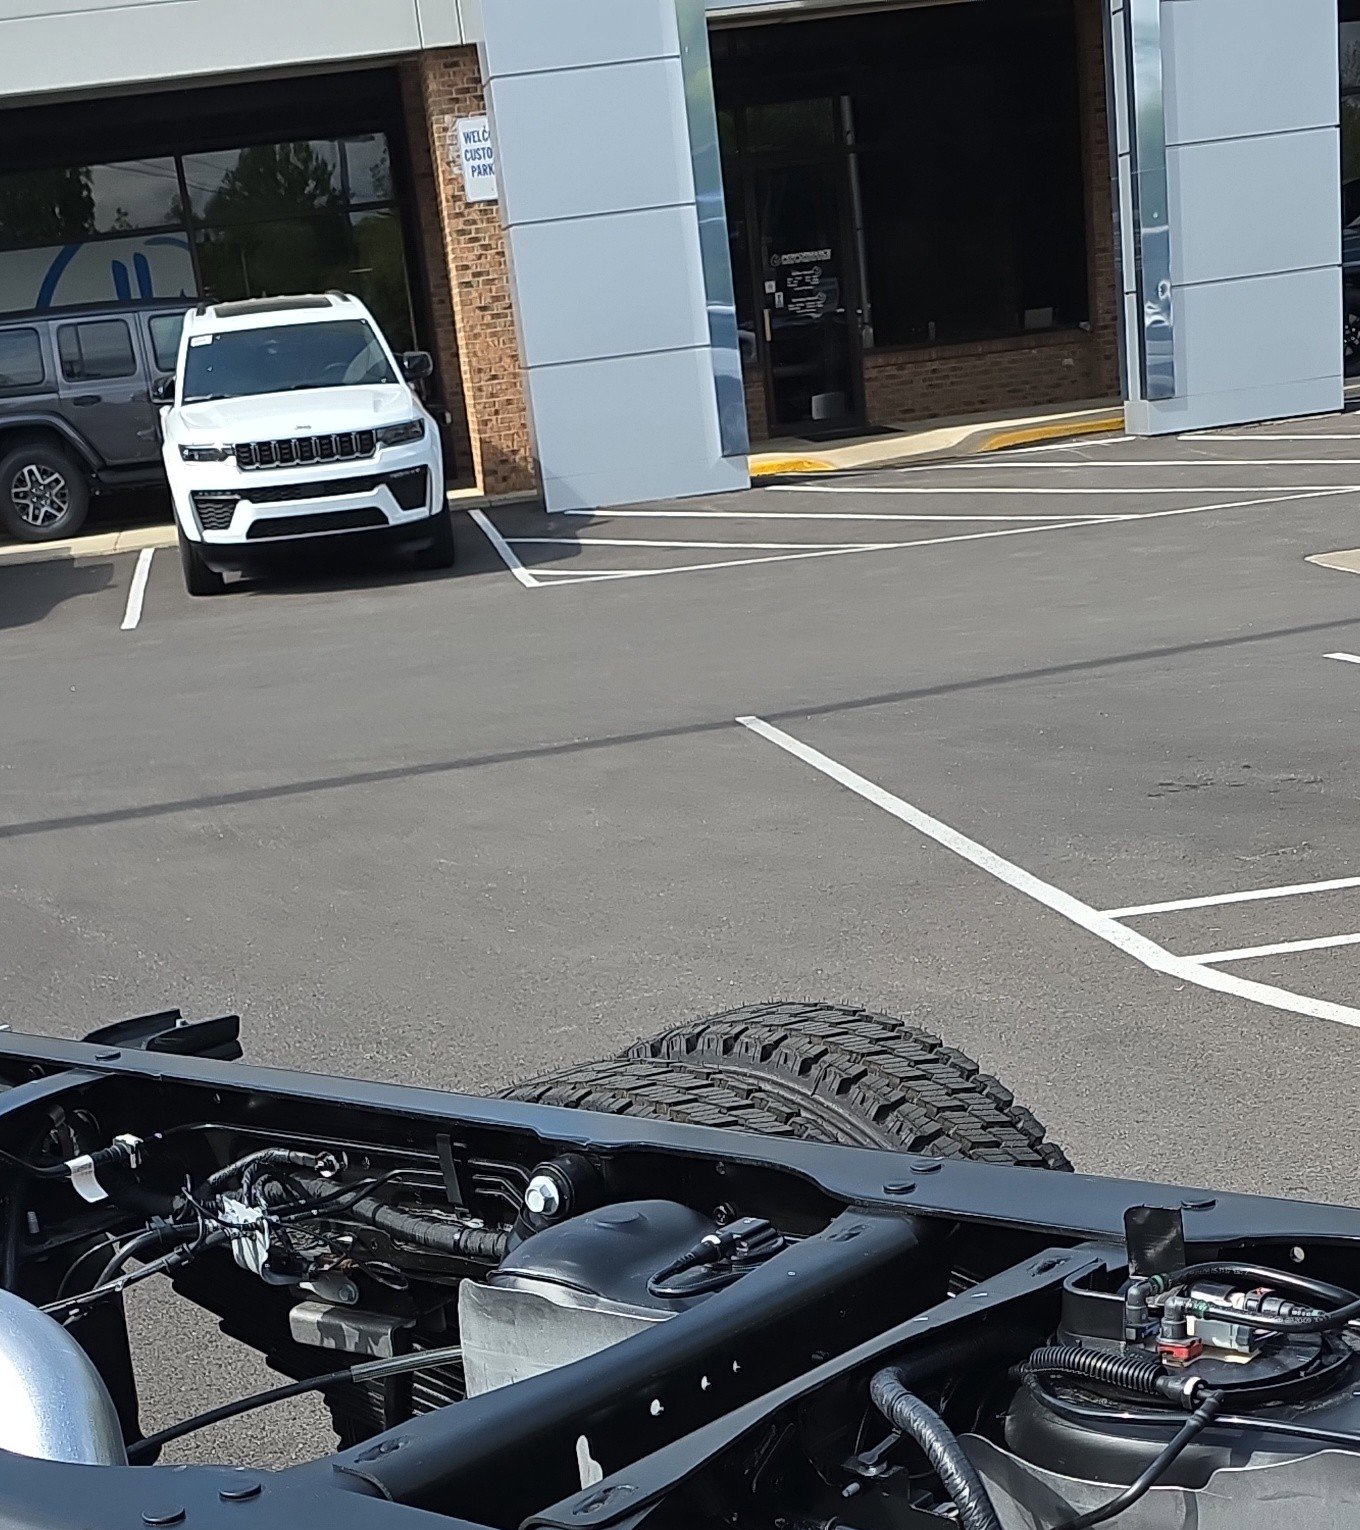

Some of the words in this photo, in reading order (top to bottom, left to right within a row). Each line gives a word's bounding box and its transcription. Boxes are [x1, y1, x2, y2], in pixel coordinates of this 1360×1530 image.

[463, 128, 491, 145] WELC
[464, 147, 493, 162] CUSTO
[471, 163, 495, 178] PARK
